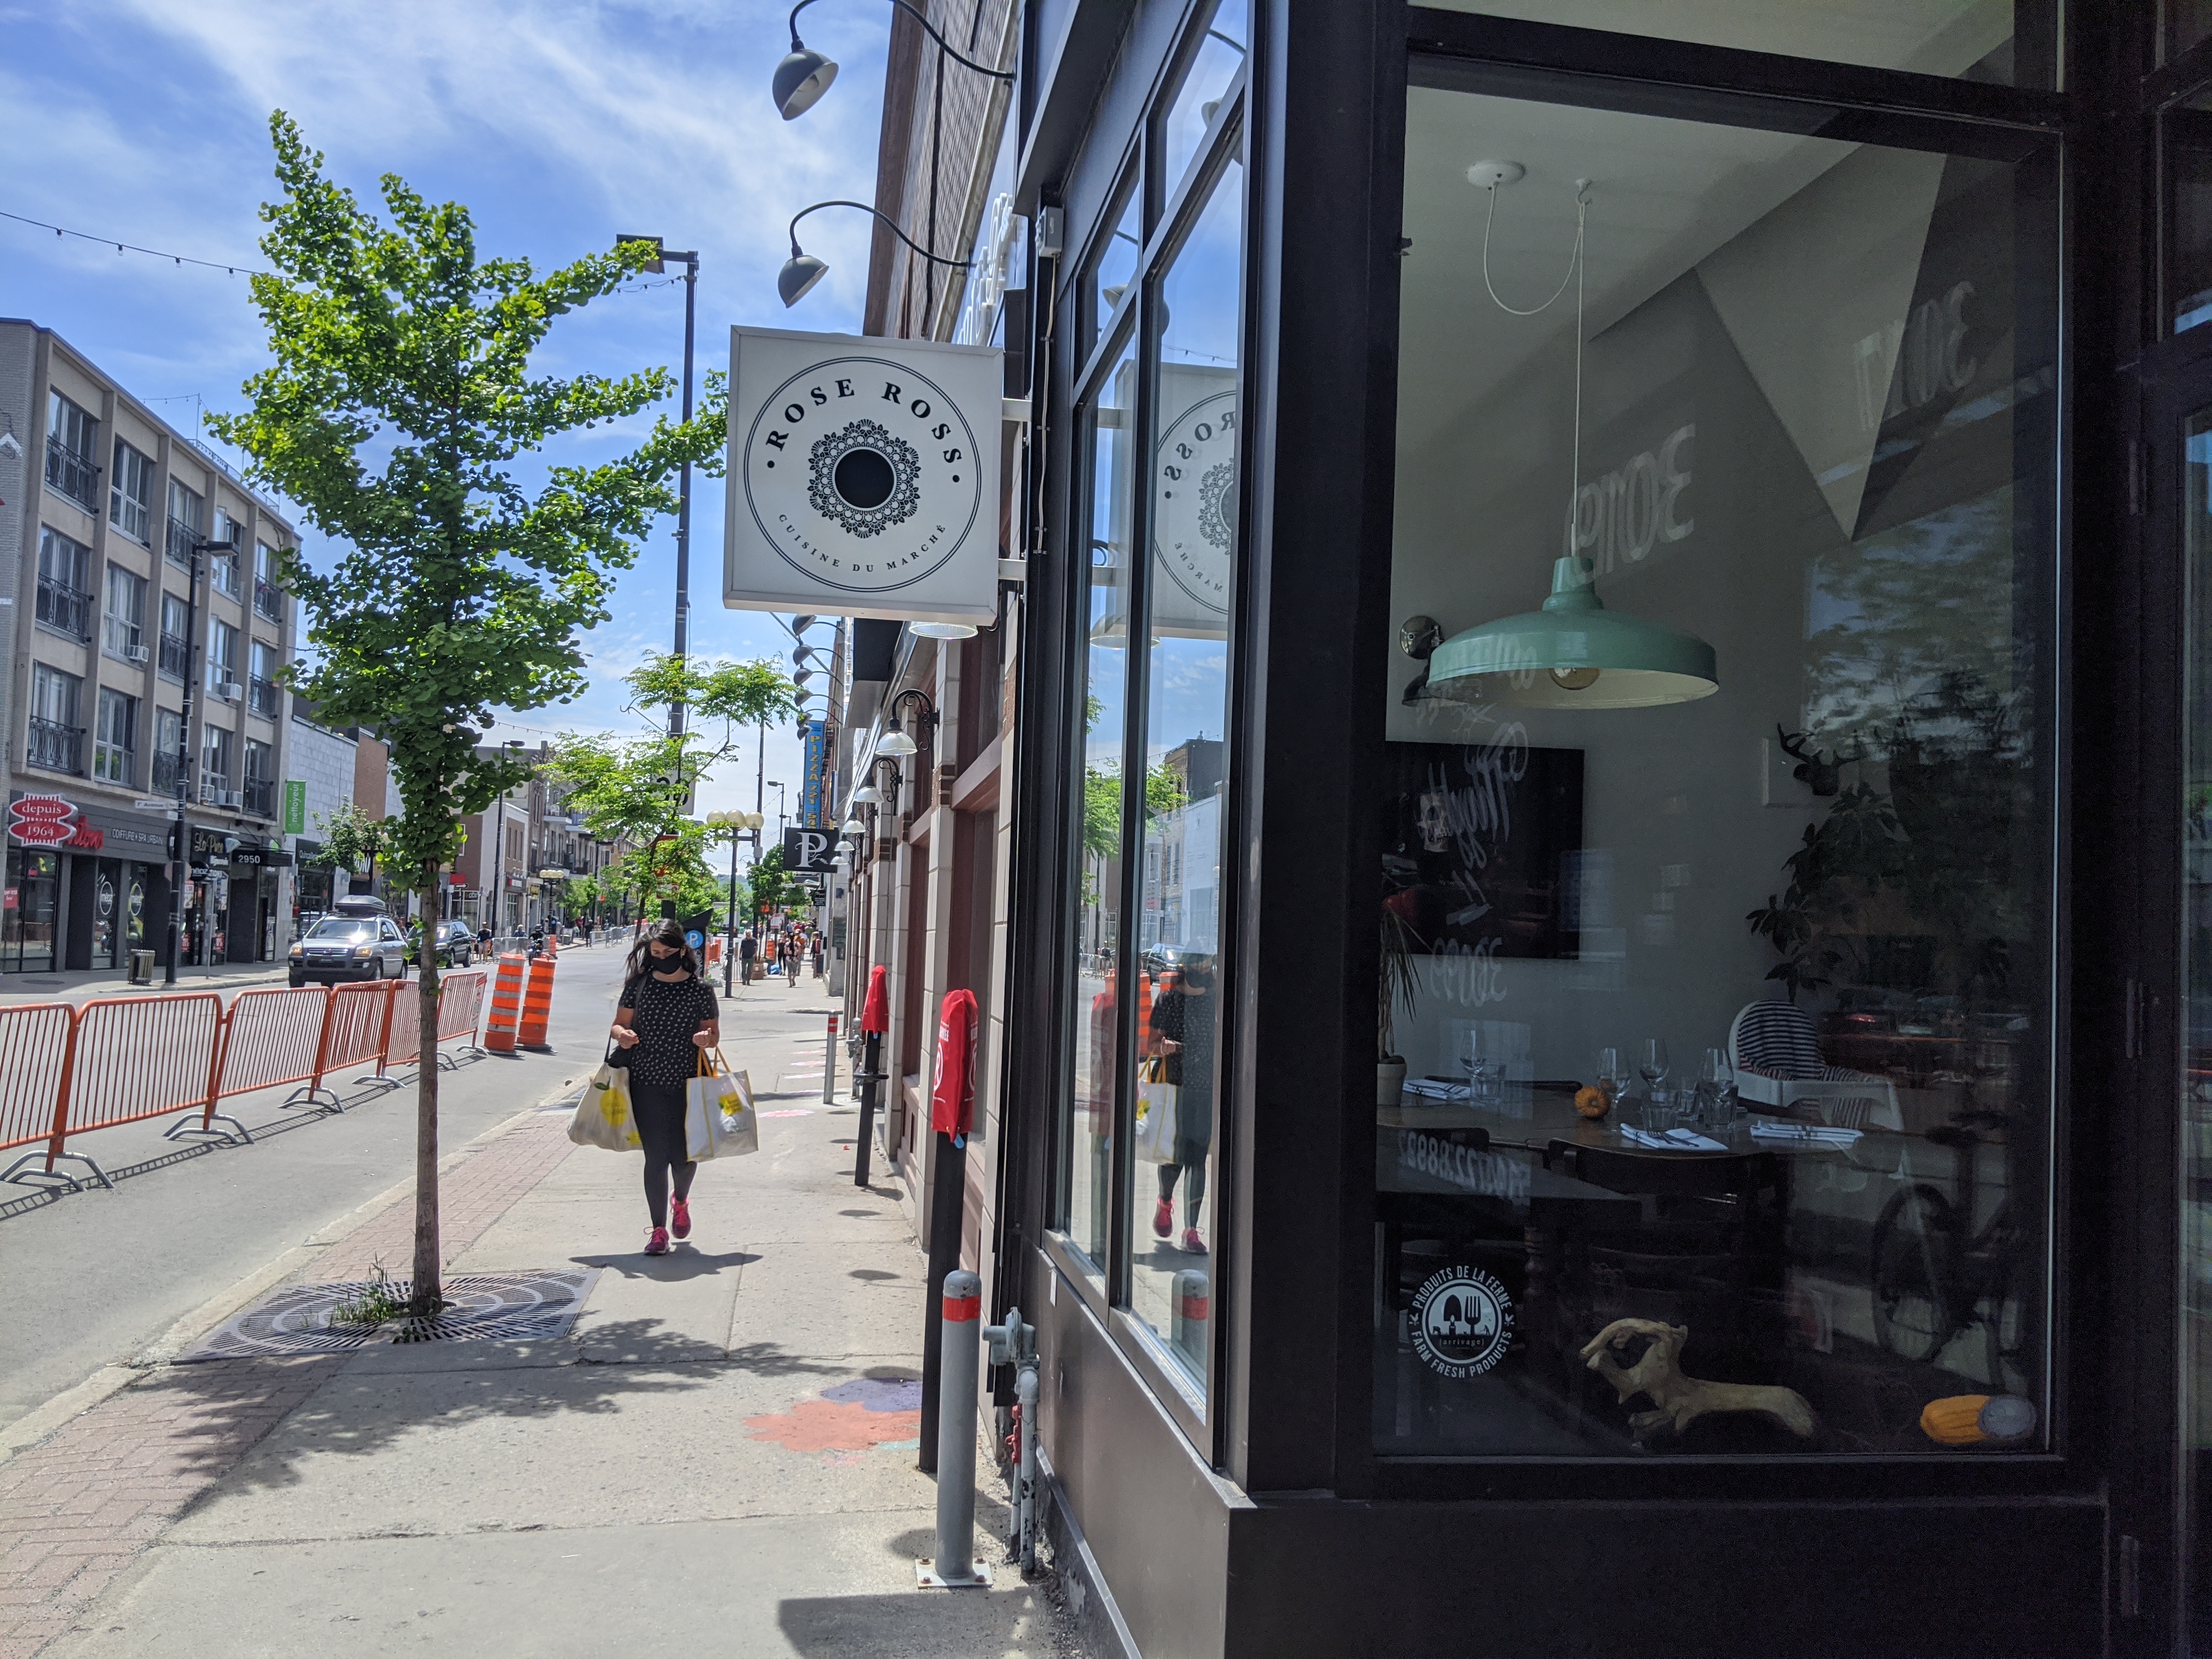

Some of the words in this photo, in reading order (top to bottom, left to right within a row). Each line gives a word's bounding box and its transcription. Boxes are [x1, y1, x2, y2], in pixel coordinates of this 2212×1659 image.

[766, 379, 855, 452] ROSE
[881, 381, 962, 464] ROSS
[778, 514, 840, 567] CUISINE
[852, 563, 873, 573] DU
[886, 524, 946, 571] MARCHÉ
[808, 735, 821, 781] PIZZA
[22, 802, 61, 816] depuis
[27, 826, 54, 837] 1964
[238, 854, 261, 864] 2950
[1411, 1267, 1454, 1310] PRODUITS
[1456, 1265, 1470, 1279] DE
[1471, 1267, 1486, 1283] LA
[1485, 1275, 1513, 1310] FERME
[1410, 1330, 1433, 1363] FARM
[1430, 1358, 1466, 1379] FRESH
[1469, 1330, 1513, 1378] PRODUCTS
